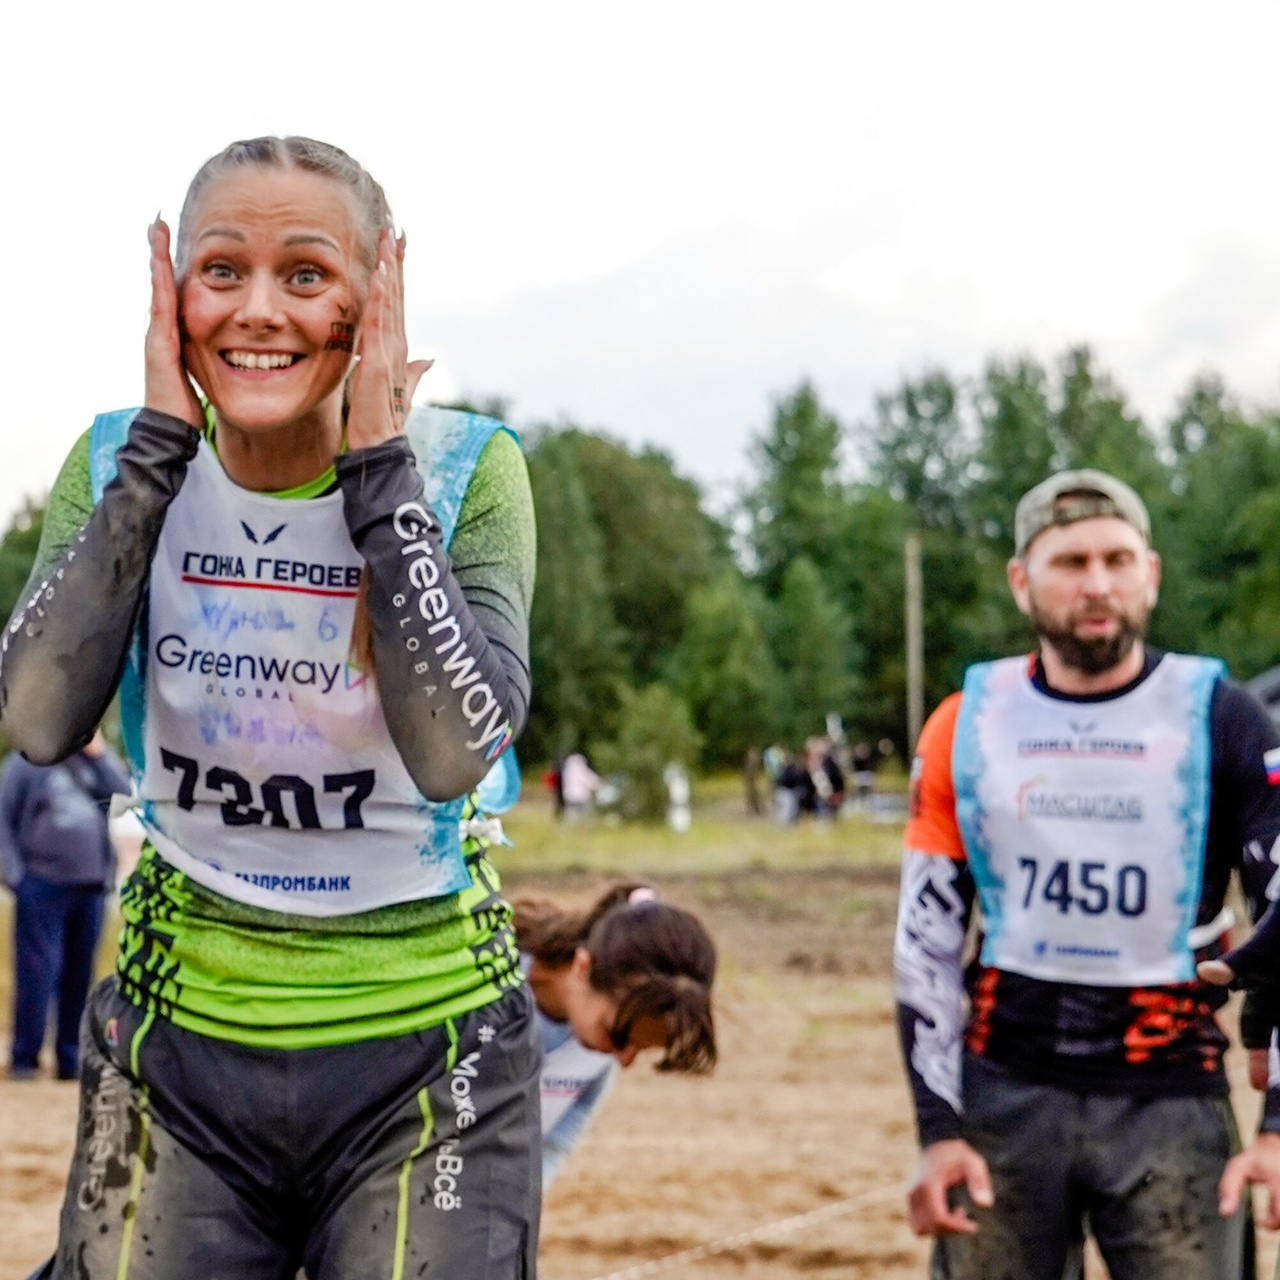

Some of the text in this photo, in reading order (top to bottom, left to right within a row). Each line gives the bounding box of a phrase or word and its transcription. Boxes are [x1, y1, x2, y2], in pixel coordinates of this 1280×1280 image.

[255, 558, 363, 587] ГЕРОЕВ
[393, 502, 509, 751] Greenway
[156, 633, 341, 696] Greenway
[205, 684, 295, 703] GLOBAL
[1017, 855, 1149, 919] 7450
